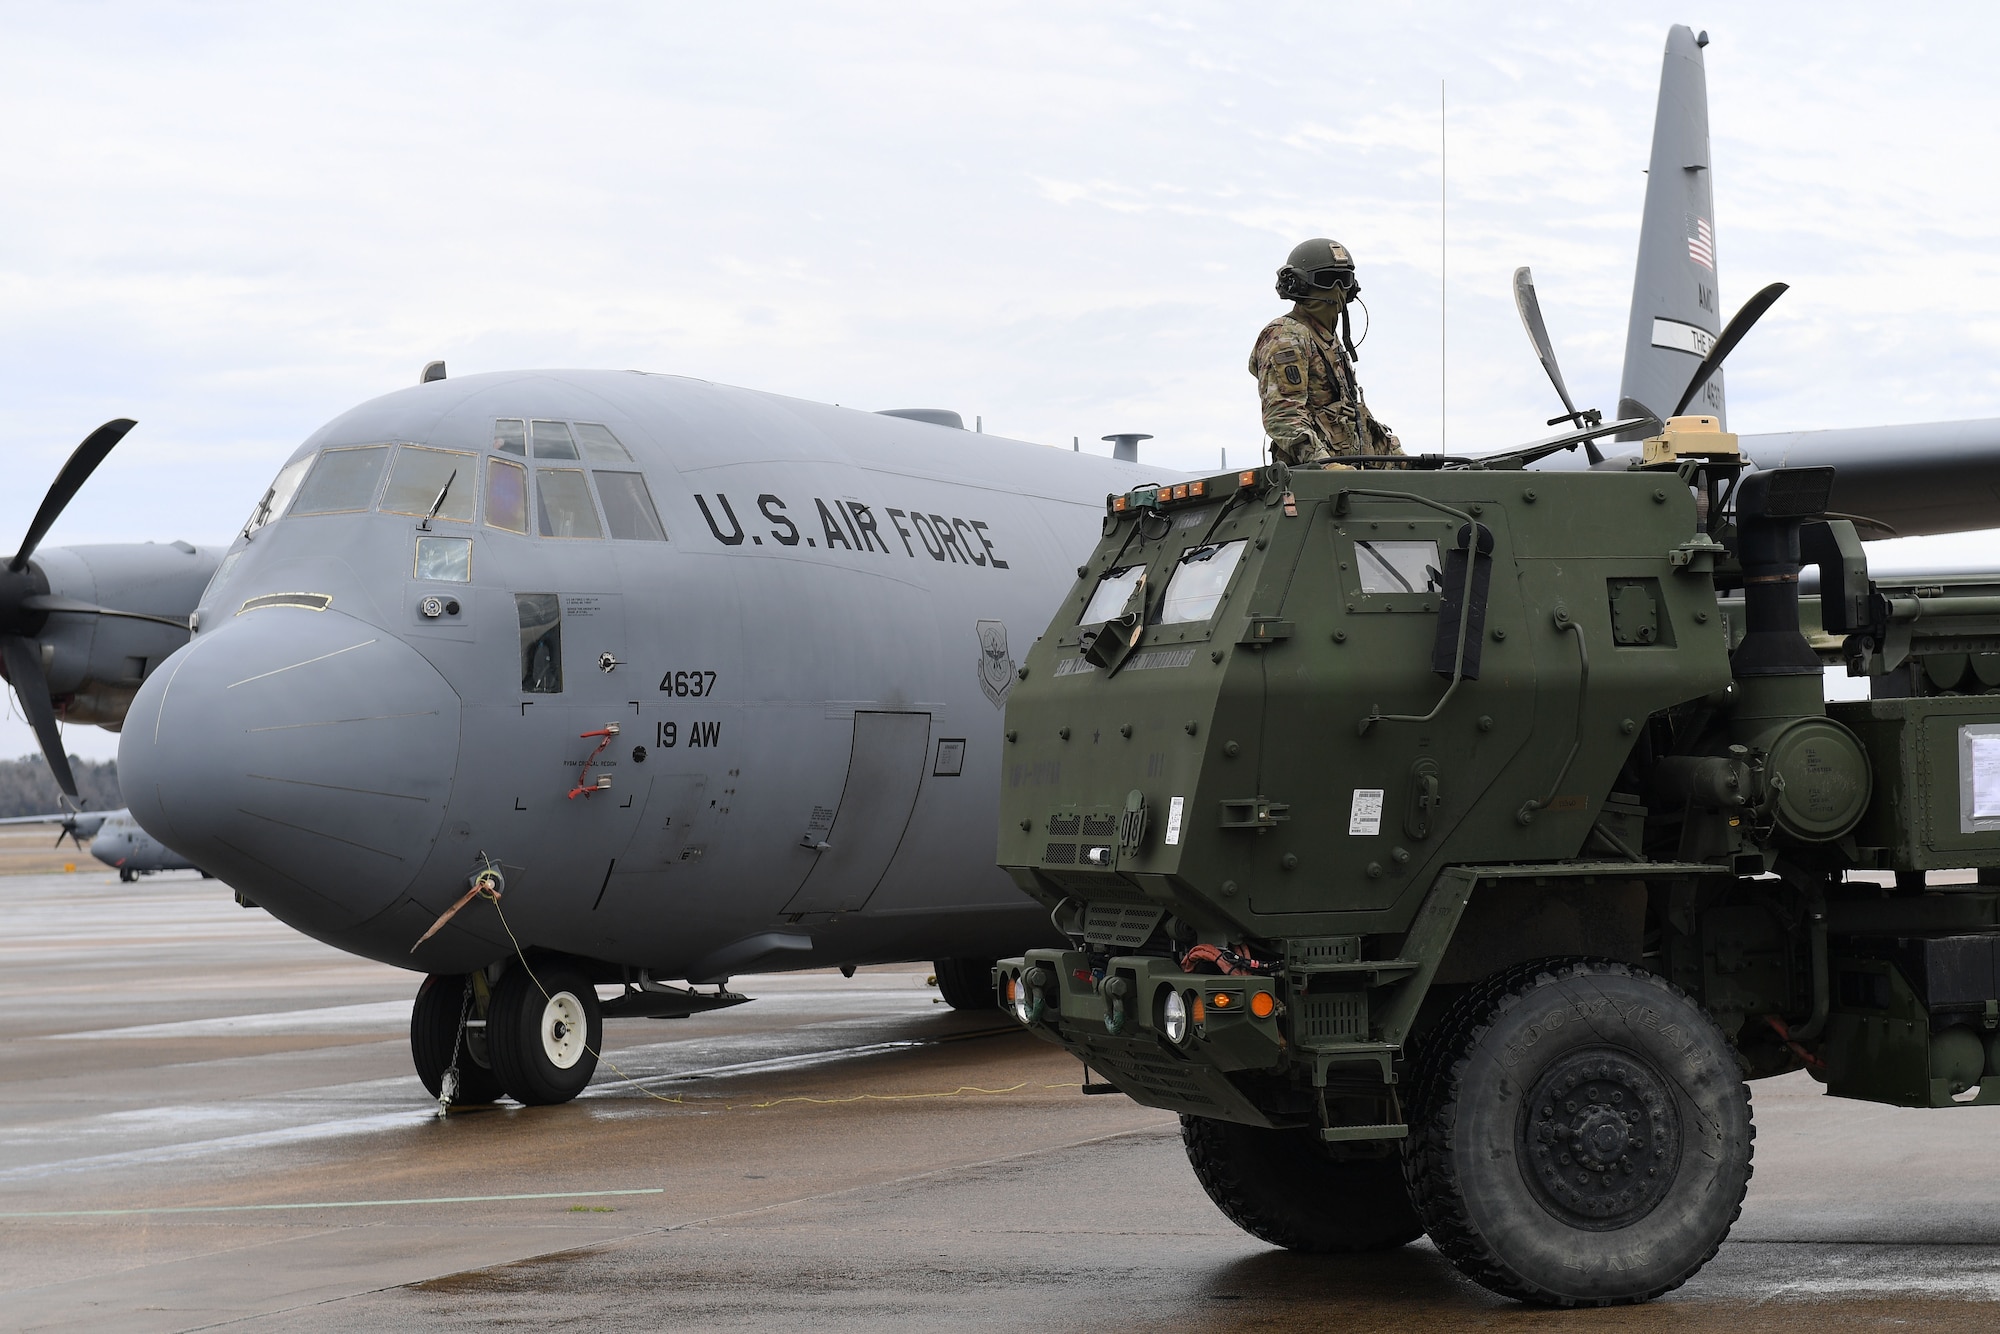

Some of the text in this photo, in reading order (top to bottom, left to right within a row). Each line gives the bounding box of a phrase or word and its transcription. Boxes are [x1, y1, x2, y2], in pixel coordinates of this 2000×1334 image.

[1698, 283, 1713, 314] AMC
[1691, 329, 1707, 354] THE
[694, 494, 1010, 570] U.S. AIR FORCE
[659, 671, 717, 697] 4637
[656, 721, 721, 748] 19 AW
[1504, 996, 1704, 1069] GOODYEAR
